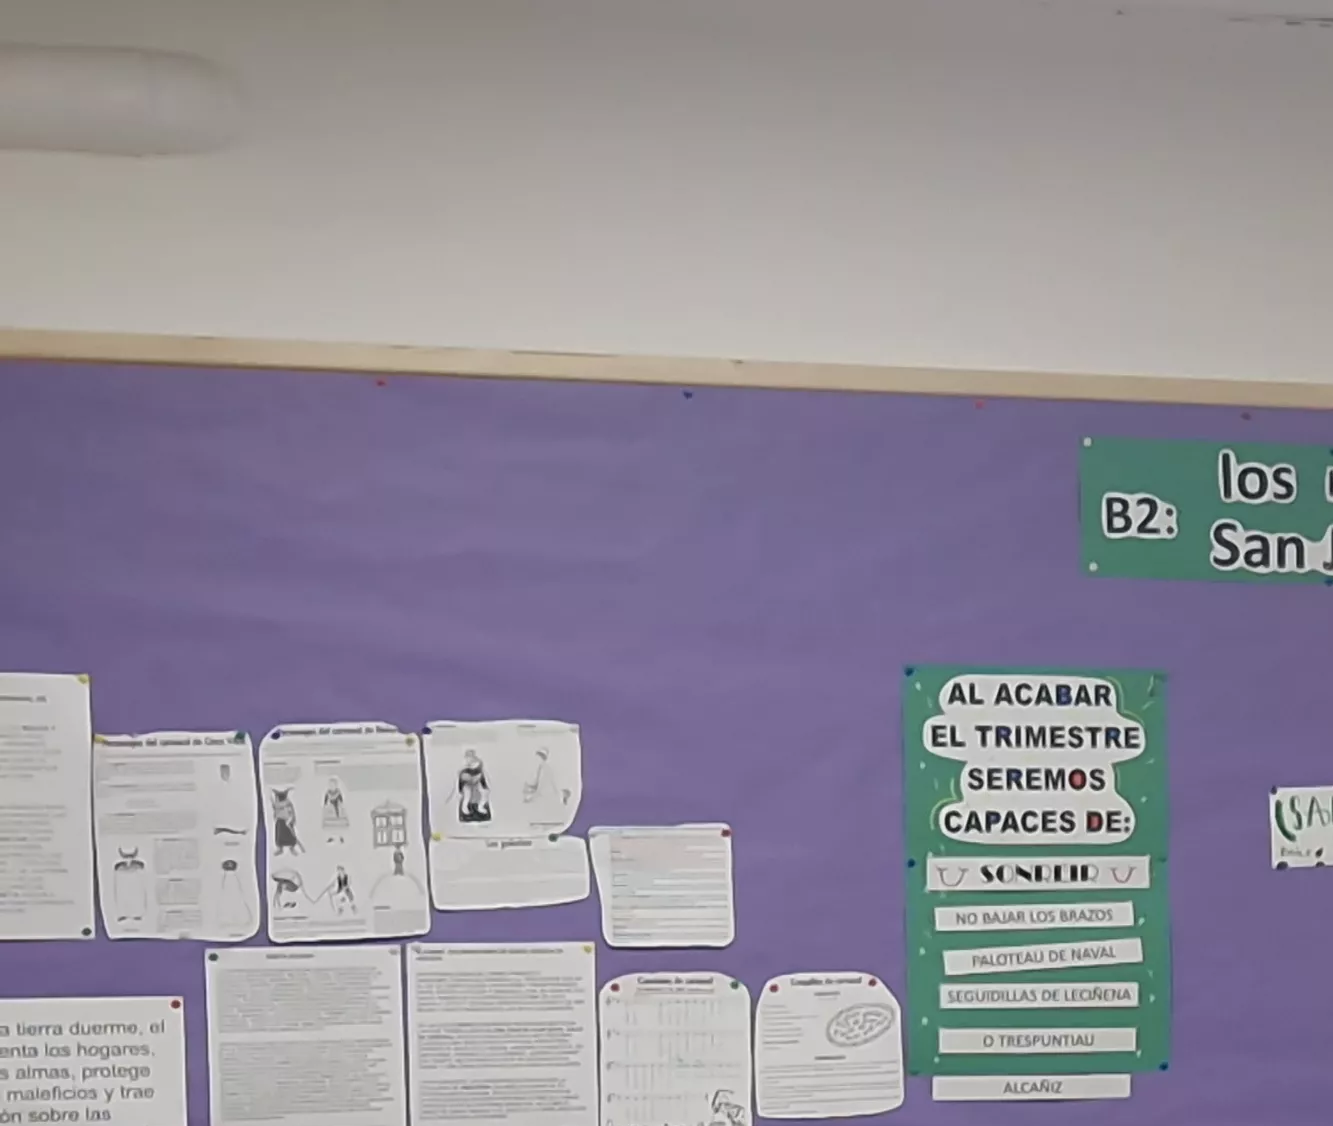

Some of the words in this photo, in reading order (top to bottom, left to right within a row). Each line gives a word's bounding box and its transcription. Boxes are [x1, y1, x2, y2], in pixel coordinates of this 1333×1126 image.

[1222, 453, 1295, 501] los
[1105, 497, 1175, 535] B2:
[1211, 522, 1305, 569] San
[948, 682, 985, 705] AL
[994, 683, 1112, 706] ACABAR
[931, 725, 966, 748] EL
[975, 725, 1141, 749] TRIMESTRE
[967, 768, 1106, 791] SEREMOS
[944, 810, 1076, 833] CAPACES
[1086, 811, 1131, 833] DE:
[980, 864, 1100, 884] SONREIR
[955, 912, 978, 925] NO
[982, 910, 1025, 925] BAJAR
[1029, 910, 1055, 923] LOS
[1060, 909, 1114, 923] BRAZOS
[972, 950, 1044, 968] PALOTEAU
[1049, 949, 1066, 963] DE
[1071, 946, 1117, 961] NAVAL
[947, 989, 1037, 1004] SEGUIDILLAS
[1041, 989, 1060, 1002] DE
[17, 1022, 62, 1036] tierra
[150, 1019, 165, 1034] el
[45, 1042, 71, 1058] los
[983, 1035, 994, 1047] O
[1000, 1034, 1095, 1048] TRESPUNTIAU
[16, 1065, 76, 1081] almas,
[82, 1065, 151, 1082] protege
[7, 1086, 97, 1102] maleficios
[104, 1087, 114, 1103] y
[120, 1085, 155, 1099] trae
[1003, 1078, 1063, 1095] ALCAÑIZ
[28, 1108, 79, 1123] sobre
[86, 1108, 112, 1122] las
